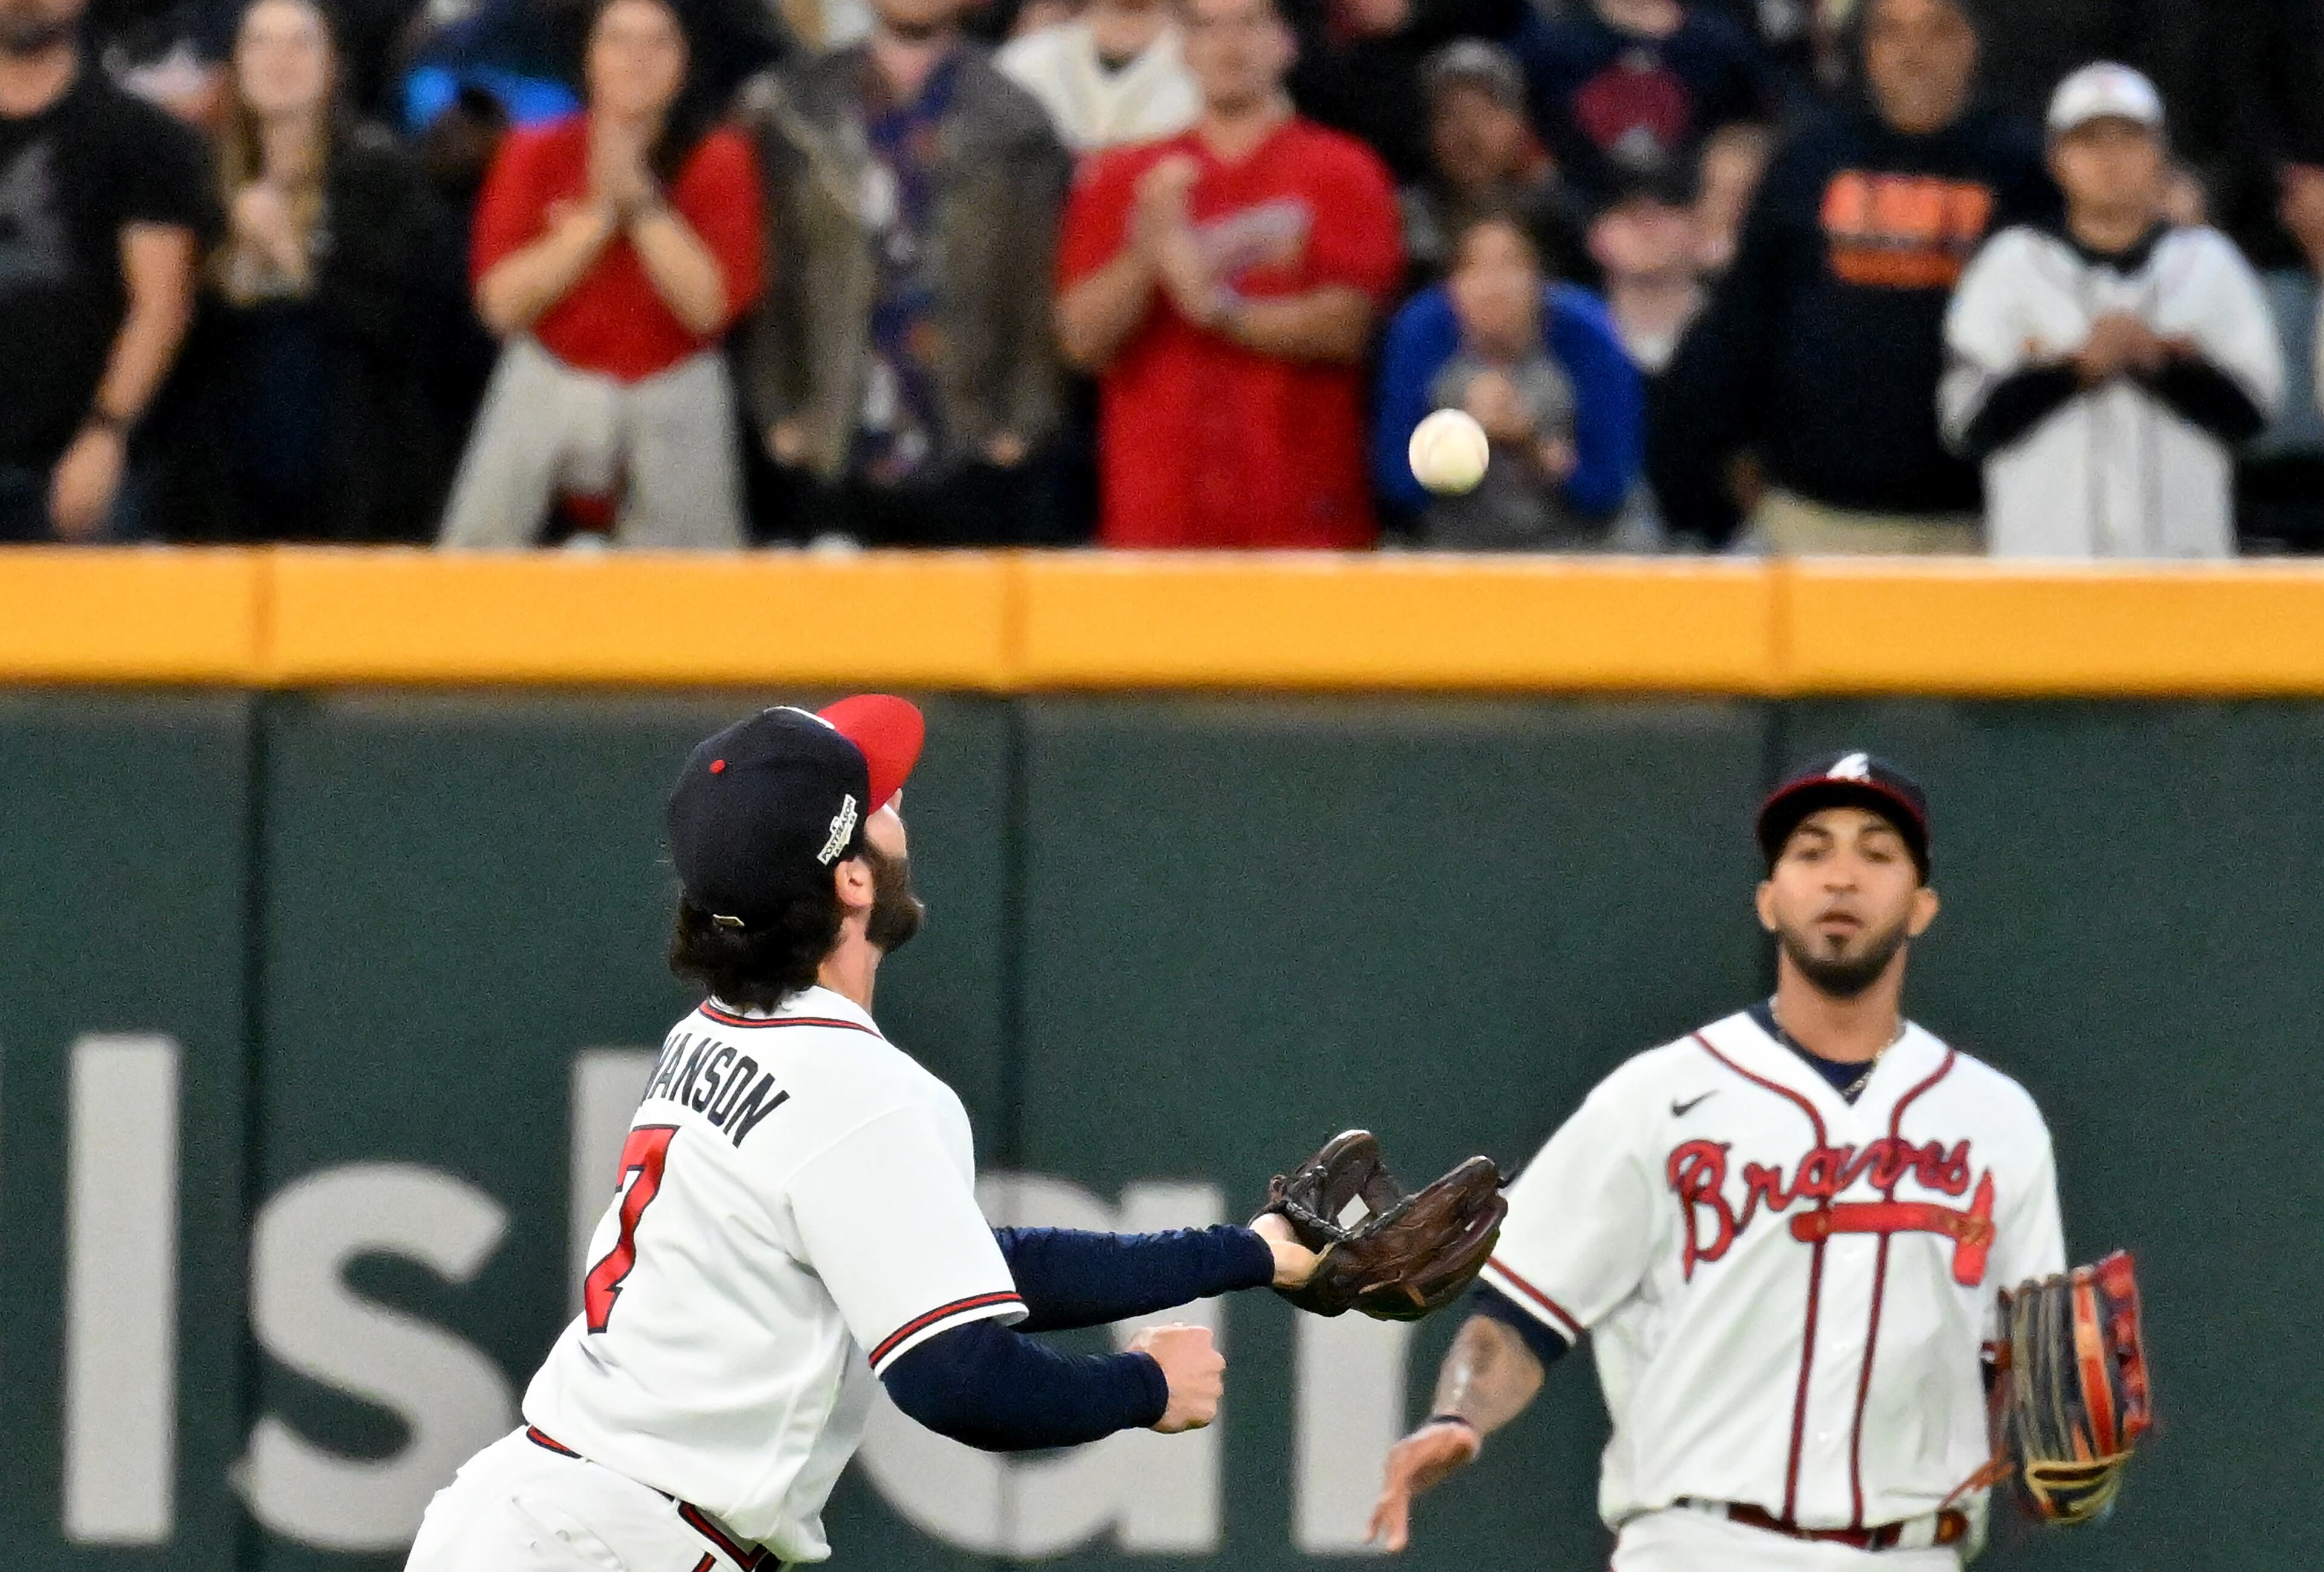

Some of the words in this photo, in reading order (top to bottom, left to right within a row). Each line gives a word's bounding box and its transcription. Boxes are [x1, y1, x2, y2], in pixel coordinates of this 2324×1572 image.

[822, 799, 853, 860] POSTSEASON
[640, 1032, 790, 1148] ANSON
[585, 1124, 681, 1335] 7
[1668, 1139, 1972, 1283] Braves
